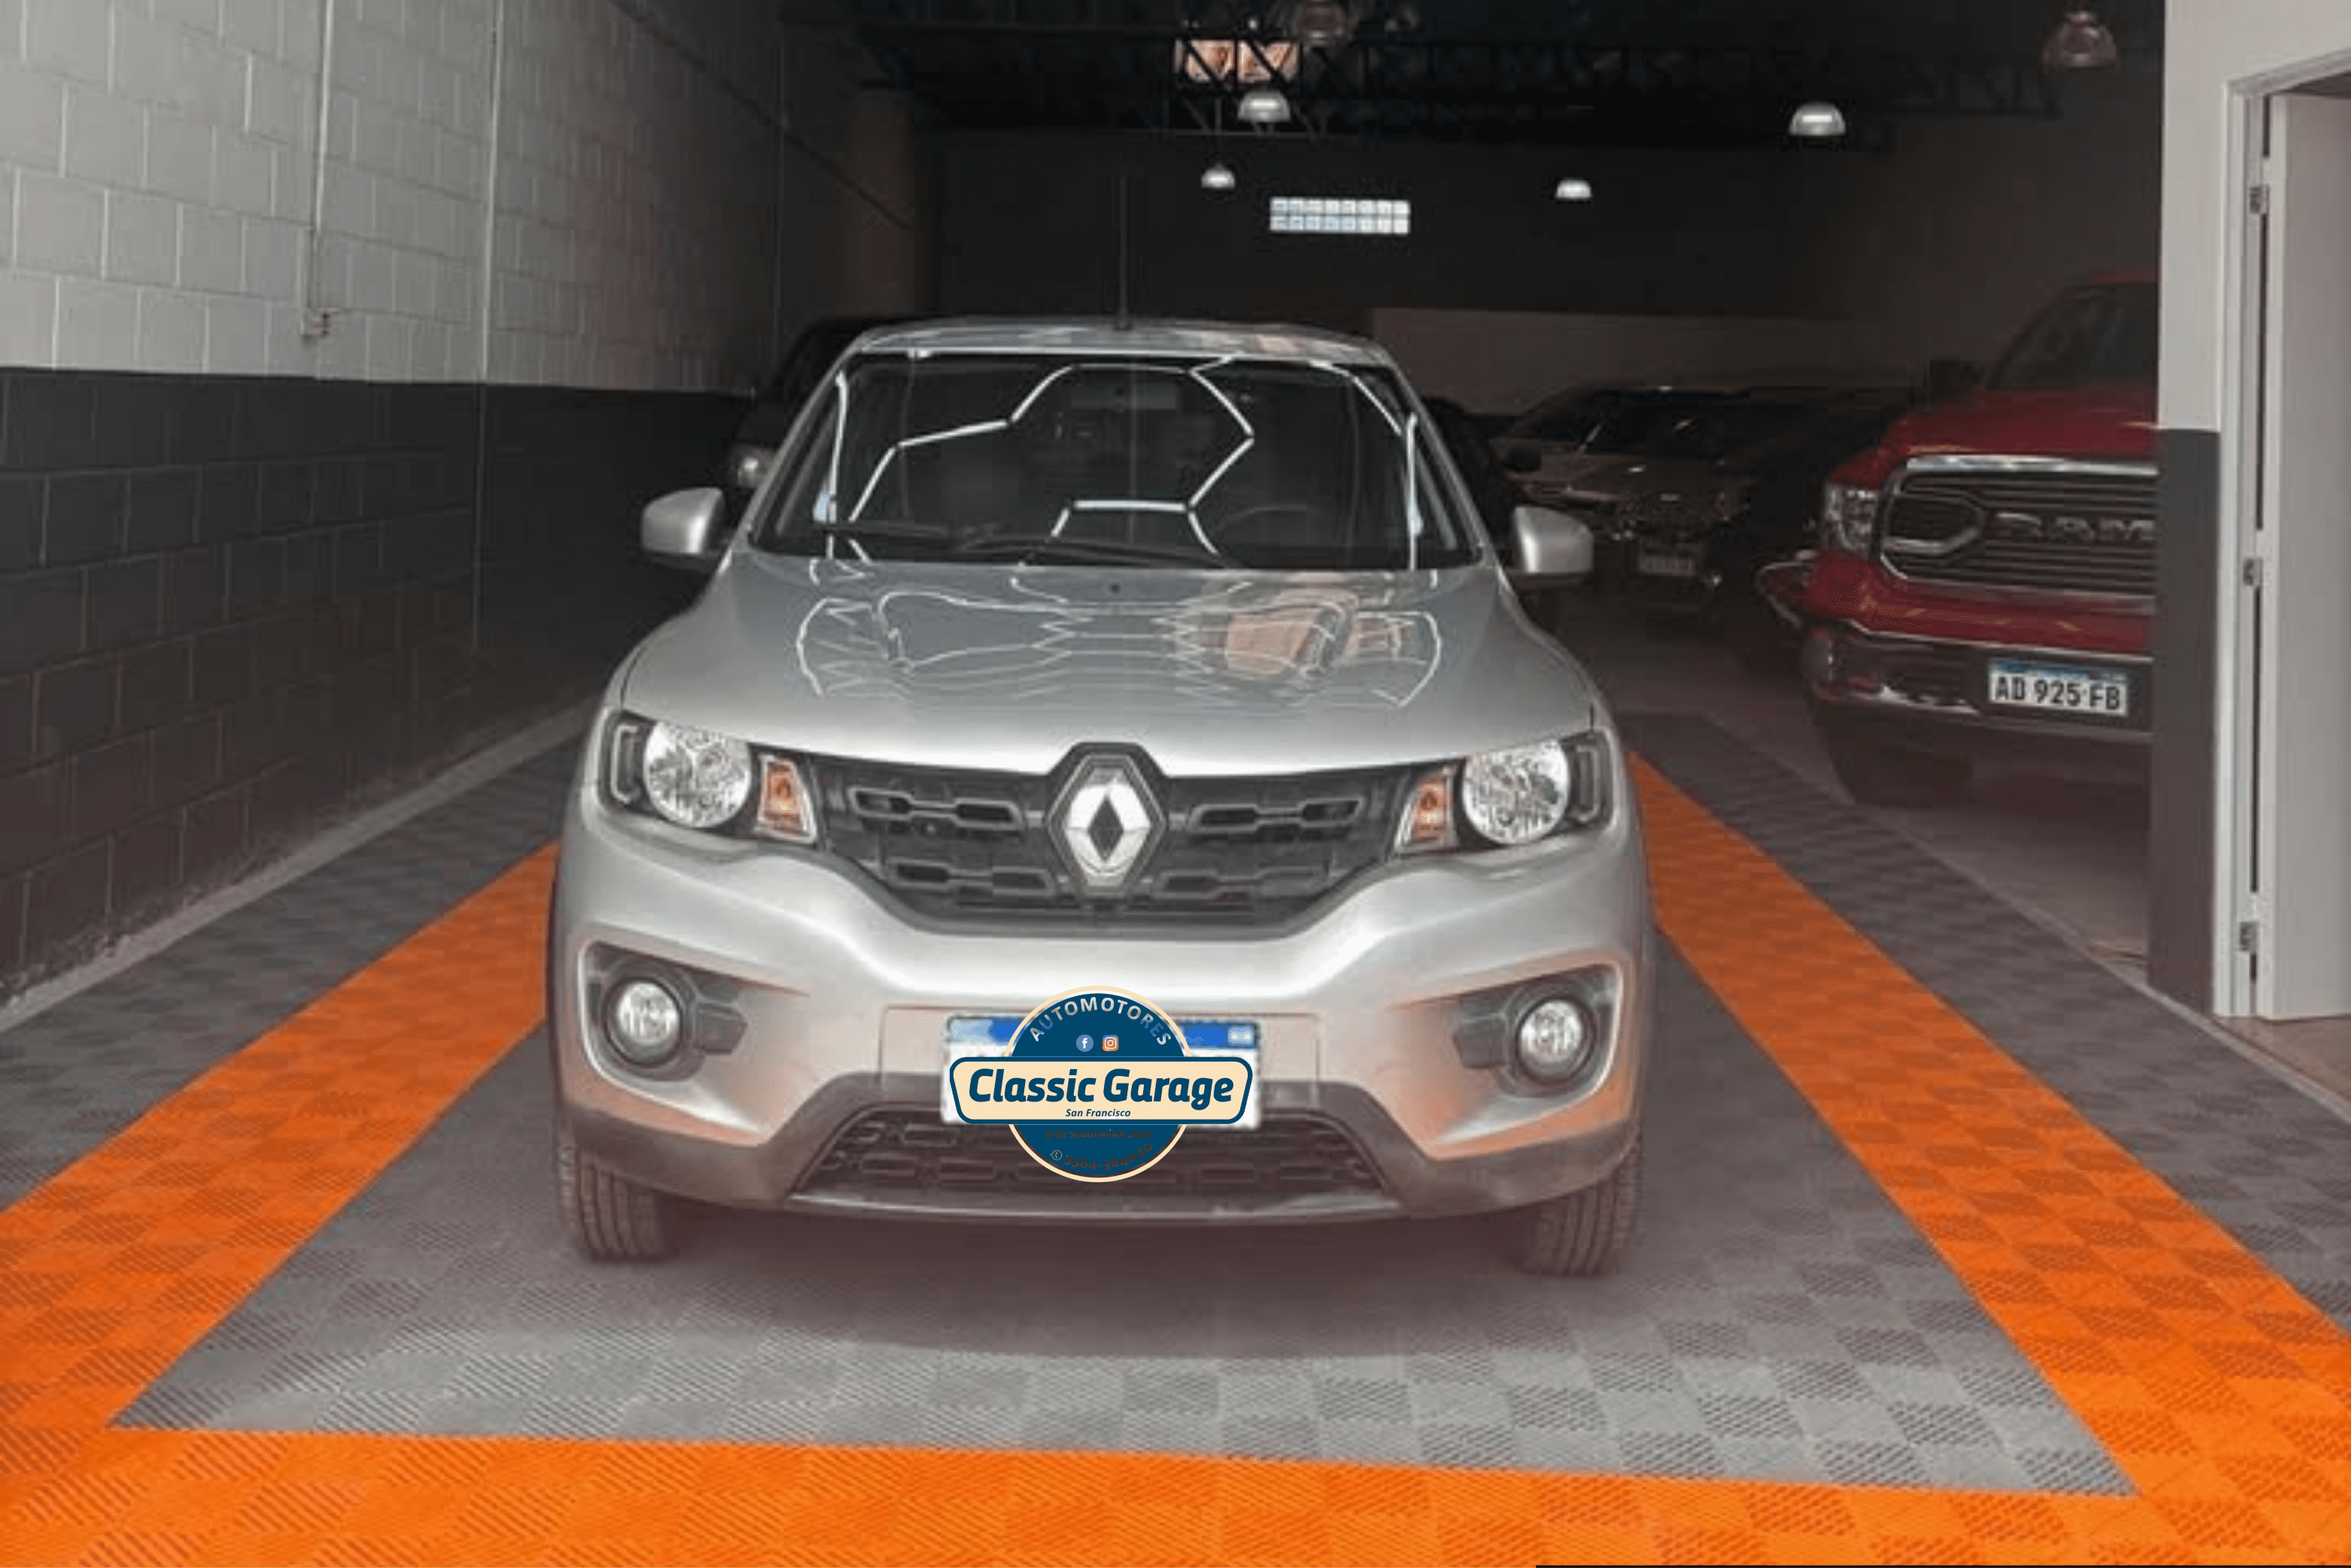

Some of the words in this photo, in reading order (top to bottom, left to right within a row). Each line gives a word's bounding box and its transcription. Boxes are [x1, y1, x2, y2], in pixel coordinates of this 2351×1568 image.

[1995, 676, 2026, 700] AD
[2034, 679, 2081, 707] 925
[2089, 683, 2121, 710] FB
